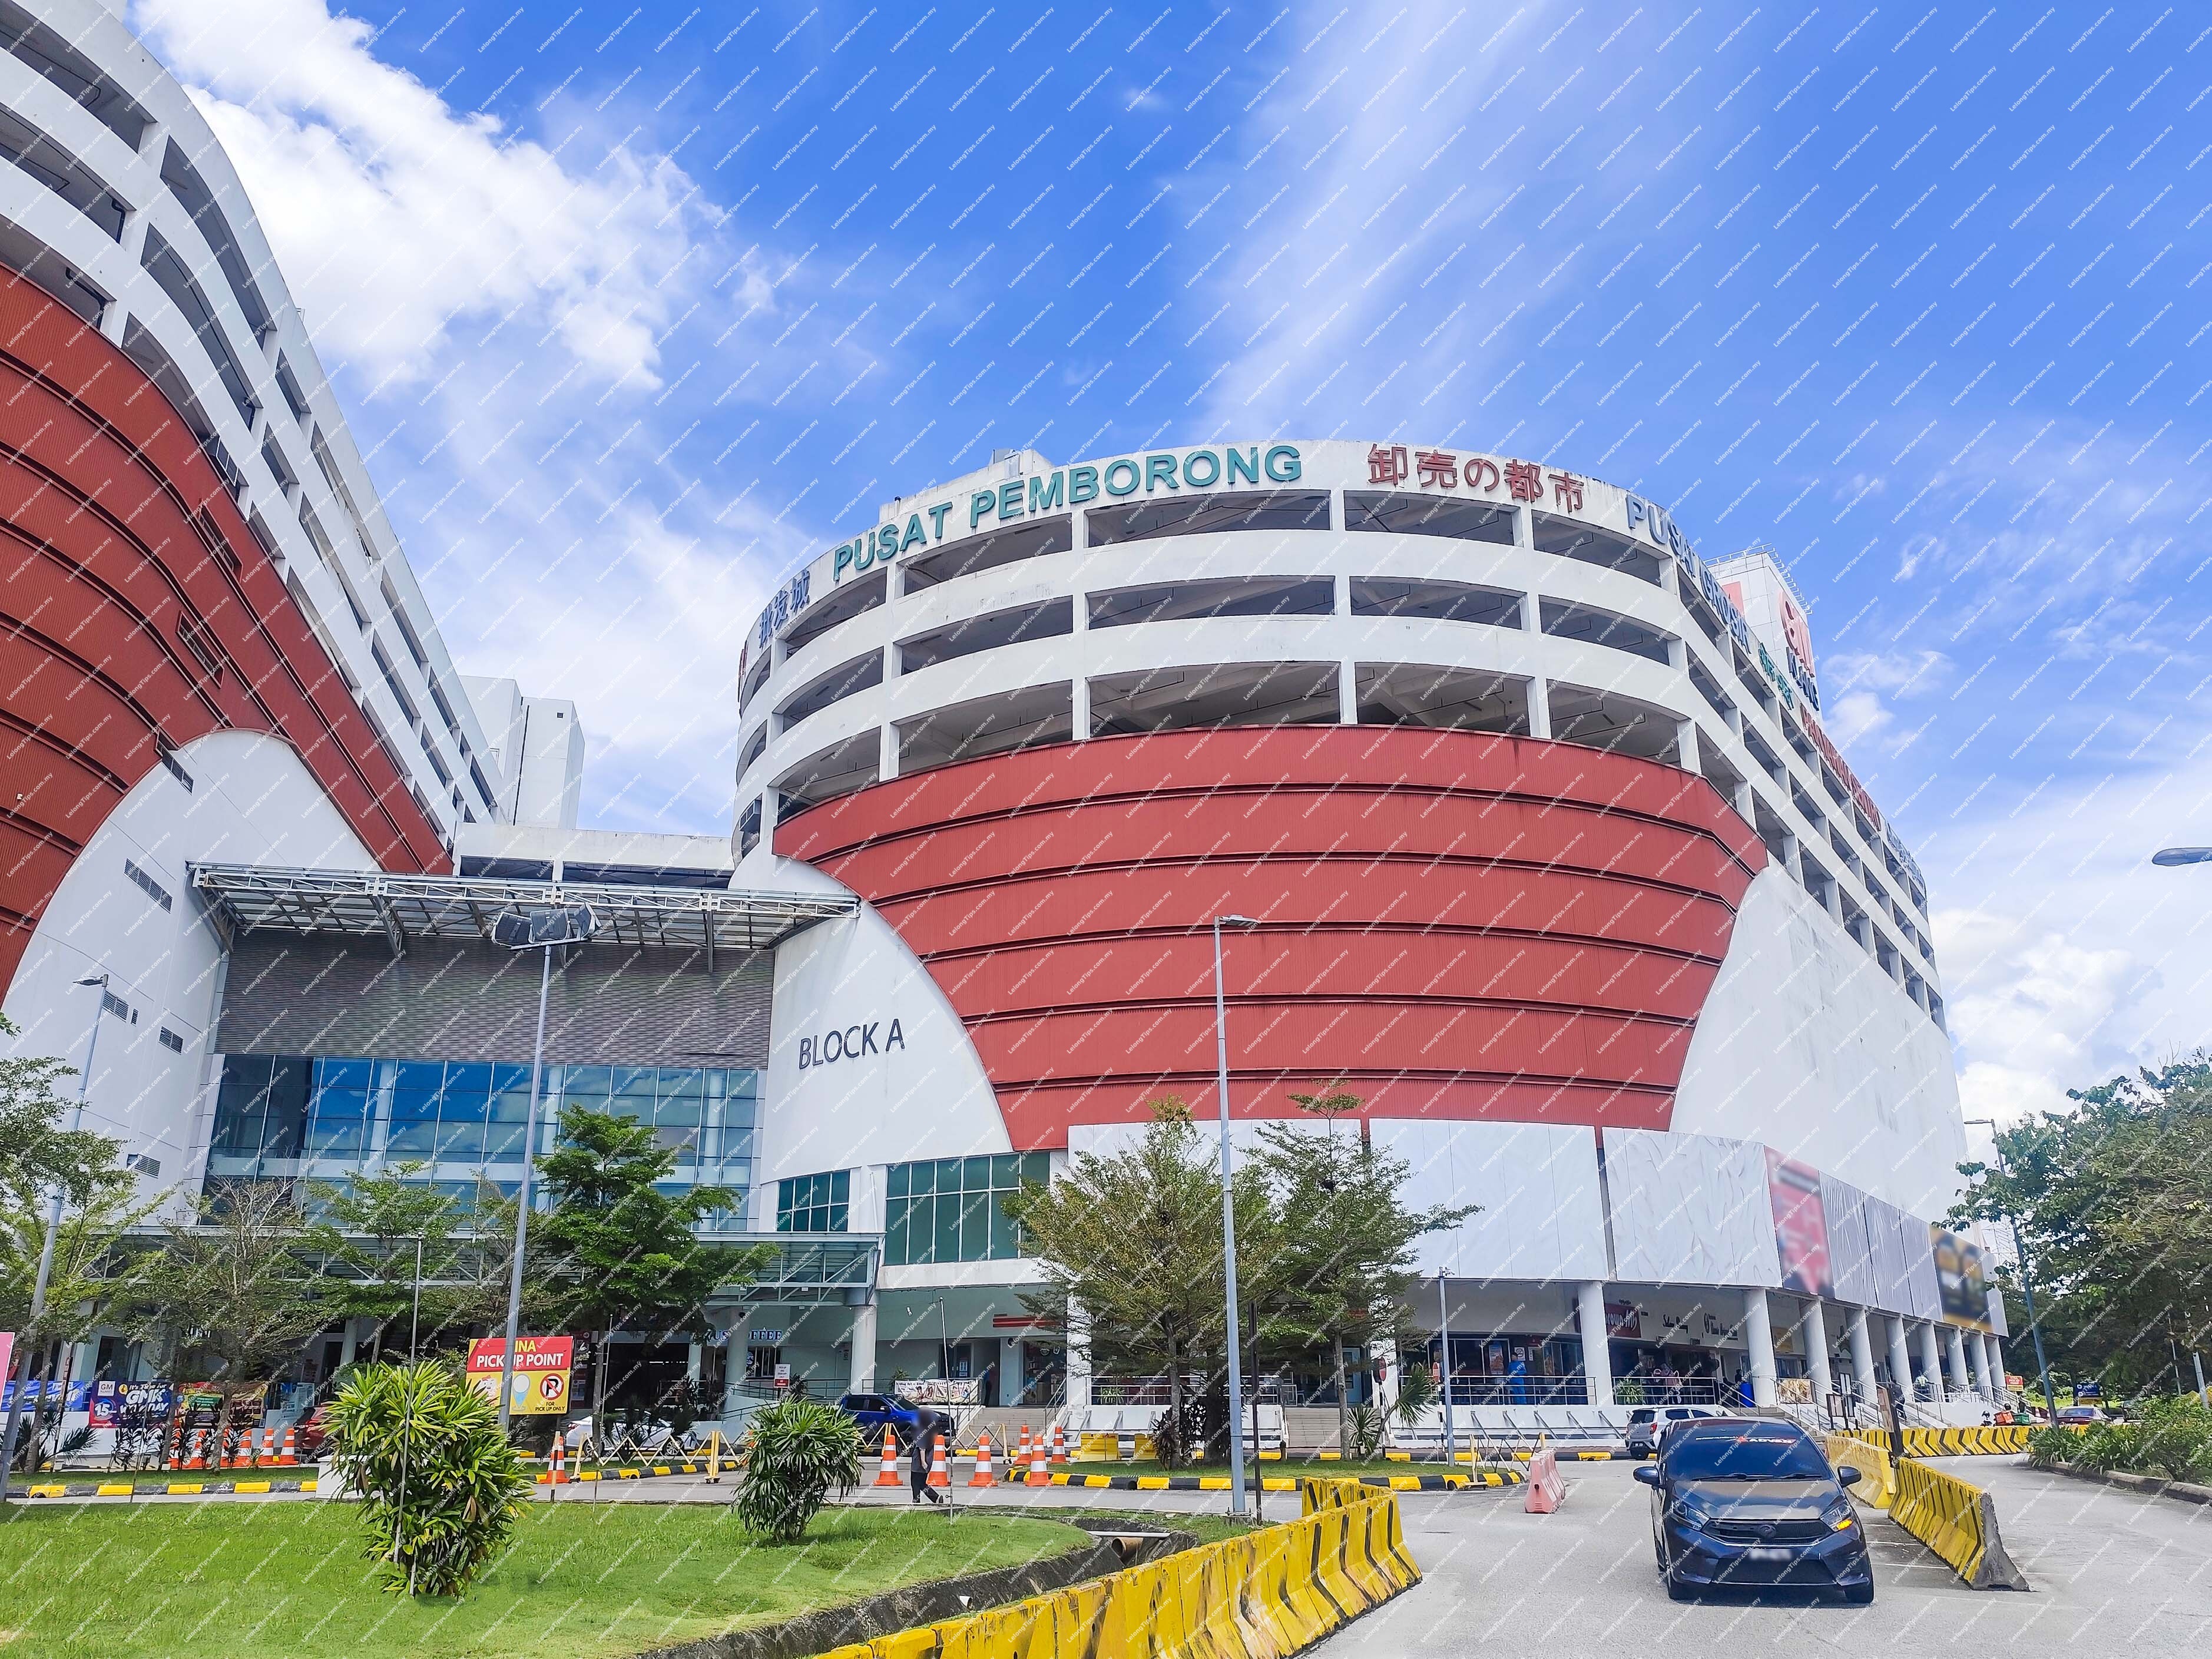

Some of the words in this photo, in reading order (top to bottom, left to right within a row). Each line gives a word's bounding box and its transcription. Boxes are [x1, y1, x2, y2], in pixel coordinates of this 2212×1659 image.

[1367, 443, 1585, 514] 卸売の都市
[833, 501, 952, 581] PUSAT
[970, 445, 1301, 528] PEMBORONG
[1626, 494, 1696, 578] PUSAT
[1700, 568, 1751, 654] GROSIR
[1786, 646, 1819, 711] KLANG
[799, 1021, 879, 1070] BLOCK
[886, 1018, 905, 1052] A
[476, 1355, 505, 1367] PICK
[526, 1353, 564, 1366] POINT
[514, 1340, 537, 1353] INA
[95, 1403, 110, 1417] 15
[125, 1388, 165, 1405] GMK
